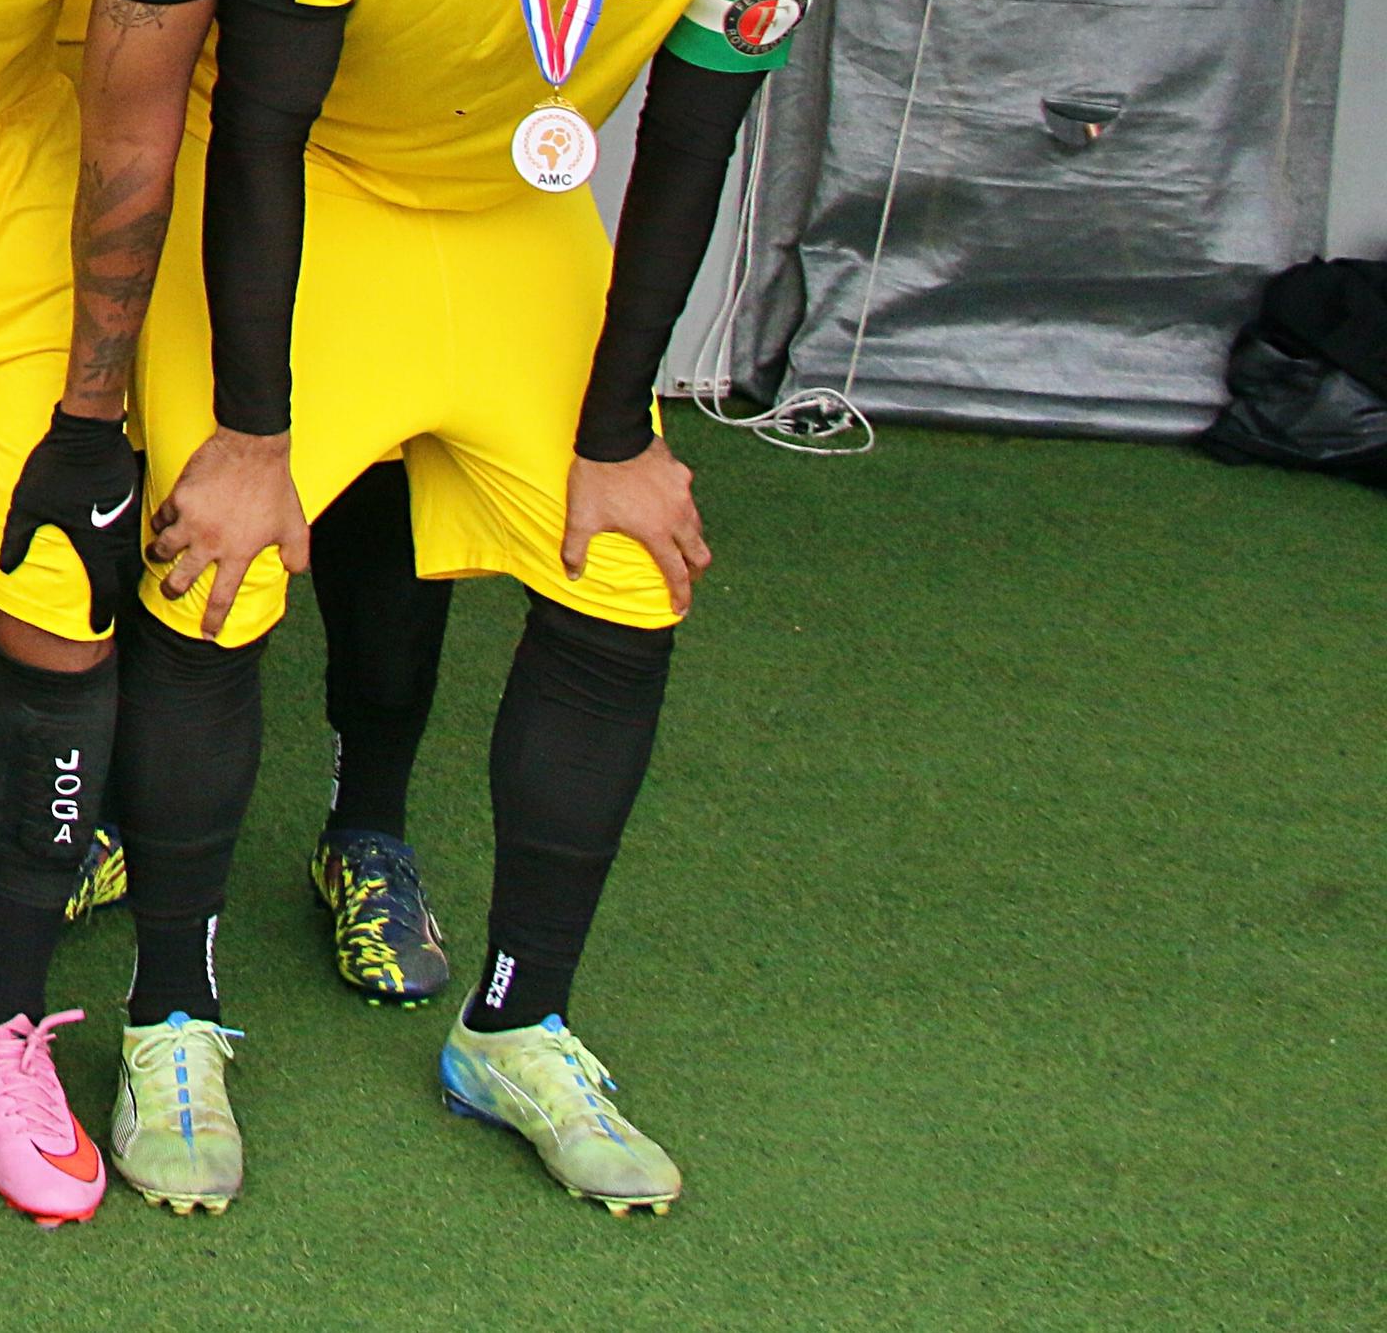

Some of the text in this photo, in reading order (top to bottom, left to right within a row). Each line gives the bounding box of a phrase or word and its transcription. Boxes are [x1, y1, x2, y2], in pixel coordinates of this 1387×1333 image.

[537, 173, 573, 186] AMC
[51, 749, 81, 844] JOGA
[485, 949, 515, 1008] SOCKS
